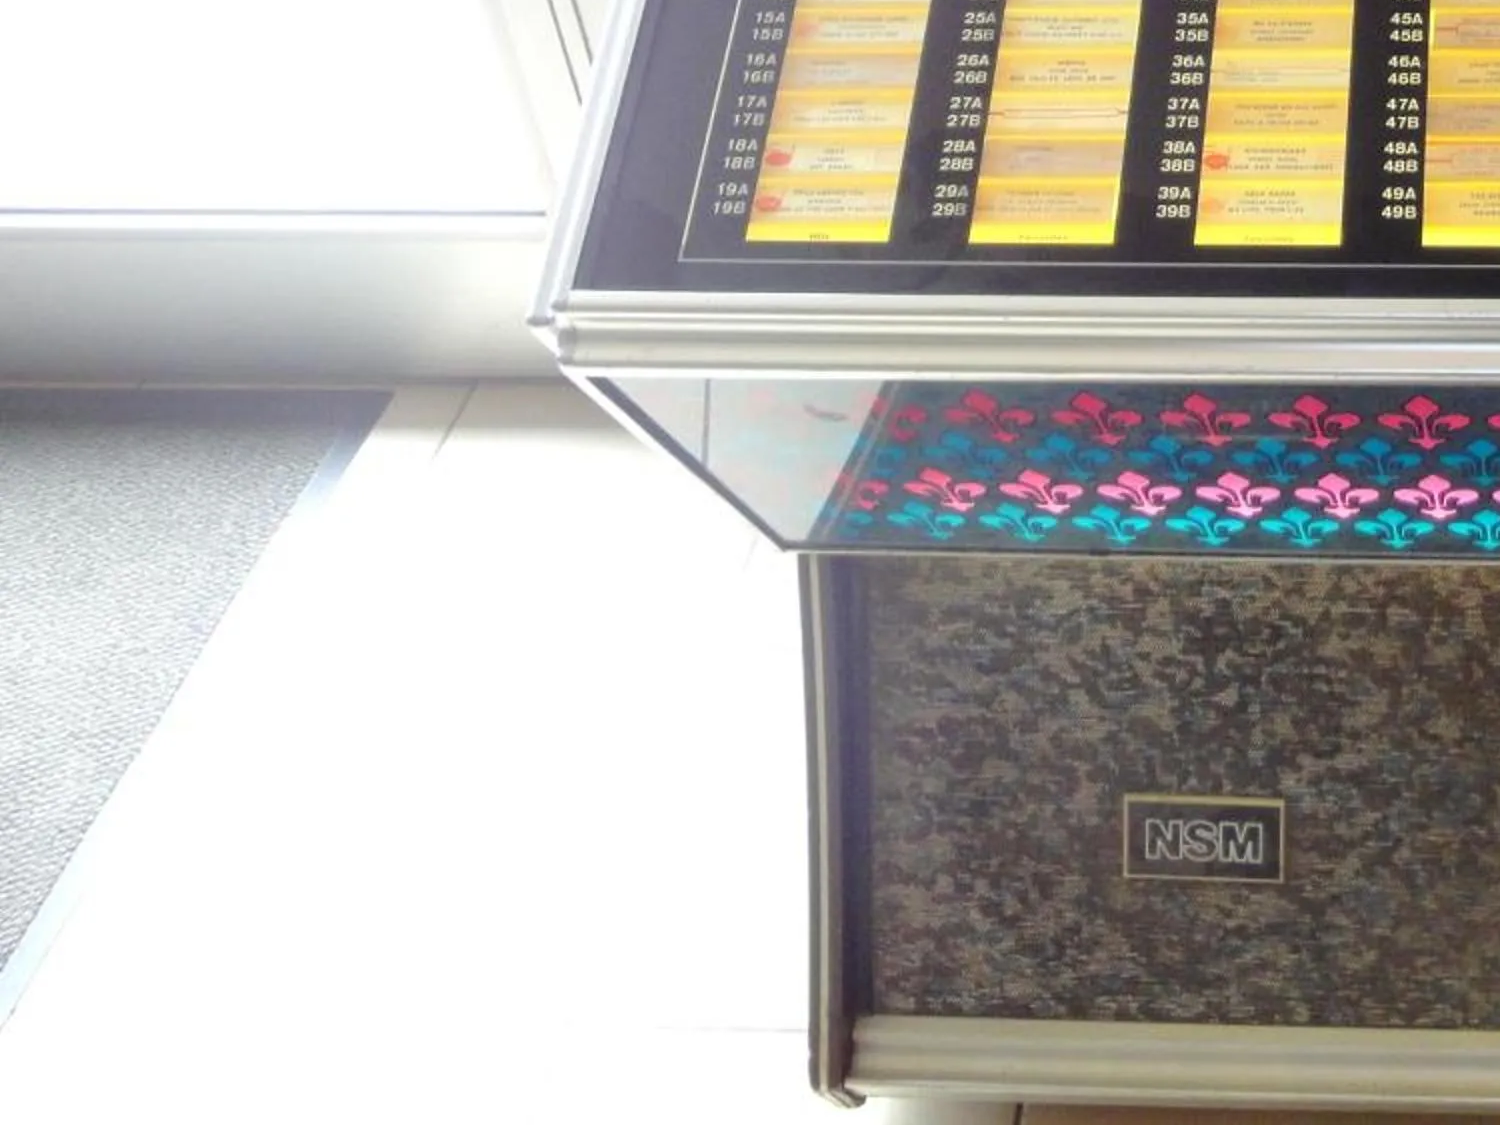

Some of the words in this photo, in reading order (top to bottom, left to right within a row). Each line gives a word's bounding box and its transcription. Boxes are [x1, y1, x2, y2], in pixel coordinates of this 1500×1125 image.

[964, 12, 996, 24] 25A
[1177, 13, 1208, 24] 35A
[1390, 13, 1422, 24] 45A
[962, 29, 994, 41] 25B
[1175, 29, 1208, 41] 35B
[1390, 29, 1423, 41] 45B
[746, 53, 776, 66] 16A
[957, 54, 989, 66] 26A
[1172, 55, 1205, 67] 36A
[1388, 55, 1421, 67] 46A
[743, 70, 774, 83] 16B
[954, 71, 987, 83] 26B
[1170, 72, 1203, 85] 36B
[1388, 72, 1421, 85] 46B
[737, 95, 767, 107] 17A
[950, 97, 982, 109] 27A
[1168, 98, 1200, 110] 37A
[1387, 98, 1419, 110] 47A
[733, 113, 765, 126] 17B
[947, 114, 981, 127] 27B
[1166, 115, 1199, 128] 37B
[1386, 116, 1419, 129] 47B
[728, 139, 757, 152] 18A
[943, 140, 975, 153] 28A
[1164, 141, 1195, 154] 38A
[1384, 142, 1418, 154] 48A
[724, 157, 755, 169] 18B
[940, 158, 973, 171] 28B
[1161, 159, 1195, 172] 38B
[1384, 159, 1418, 173] 48B
[718, 182, 748, 196] 19A
[935, 185, 968, 198] 29A
[1158, 187, 1191, 200] 39A
[1382, 187, 1416, 200] 49A
[713, 201, 745, 214] 19B
[932, 203, 966, 216] 29B
[1156, 205, 1190, 218] 39B
[1382, 205, 1416, 219] 49B
[1145, 818, 1264, 864] NSM
